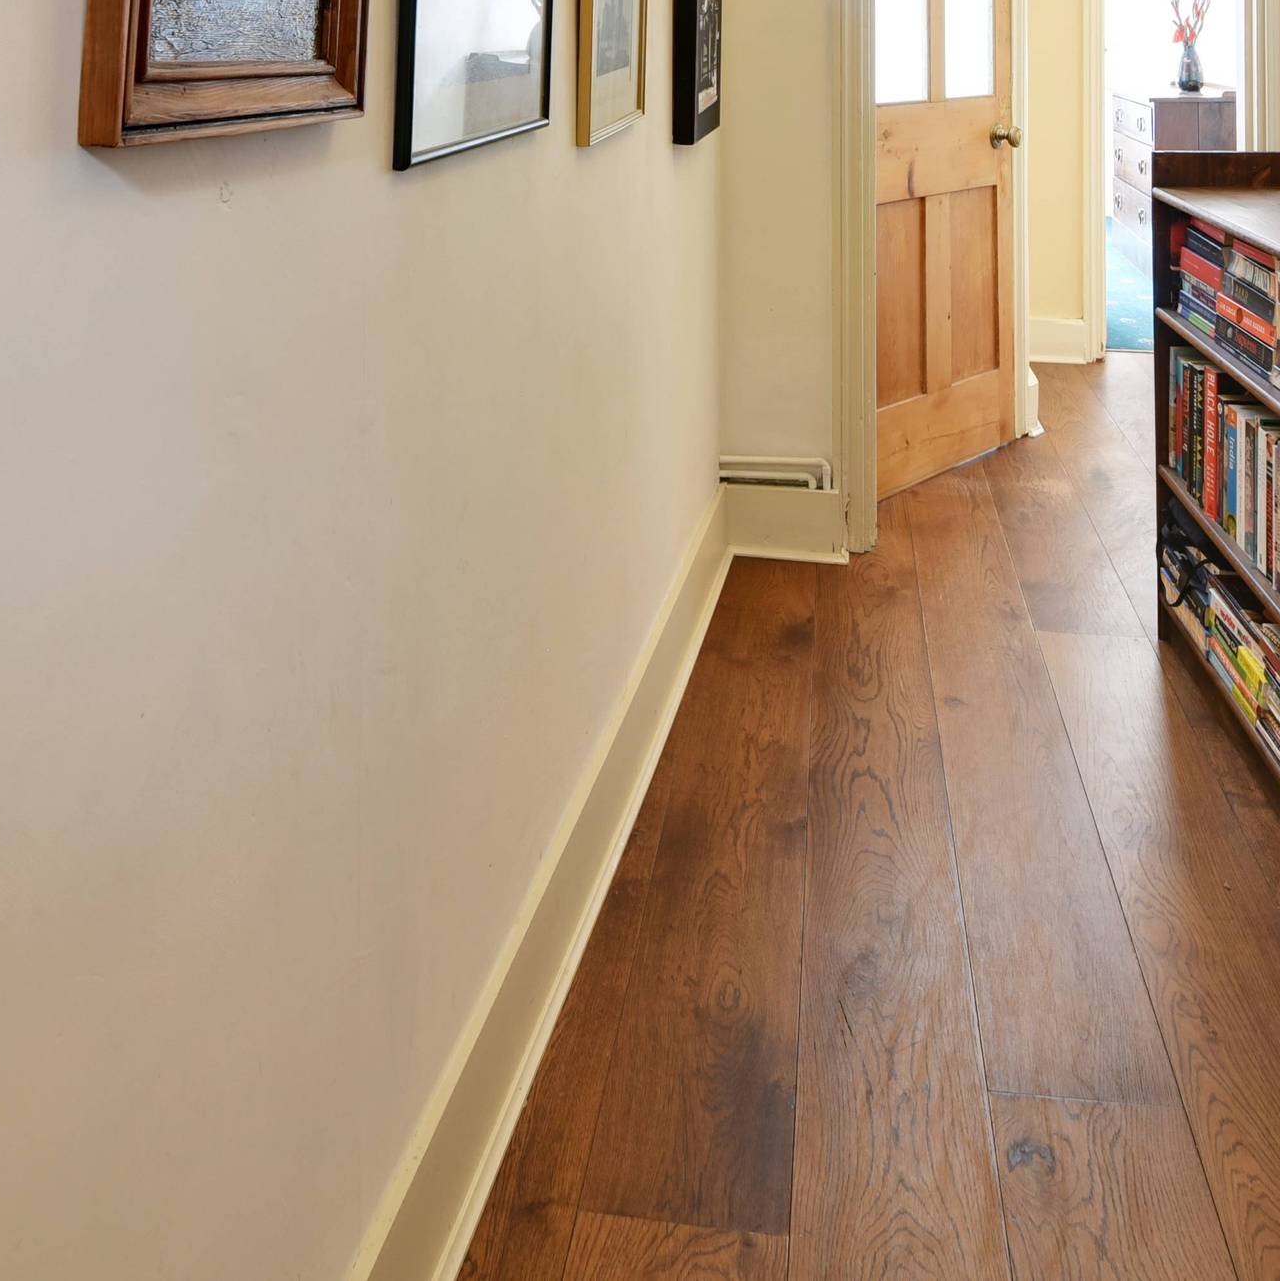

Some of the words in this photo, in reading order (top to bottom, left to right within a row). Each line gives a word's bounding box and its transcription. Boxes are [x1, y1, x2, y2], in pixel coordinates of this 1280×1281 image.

[1206, 372, 1216, 414] BLACK
[1206, 419, 1216, 457] HOLE
[1229, 436, 1238, 470] India
